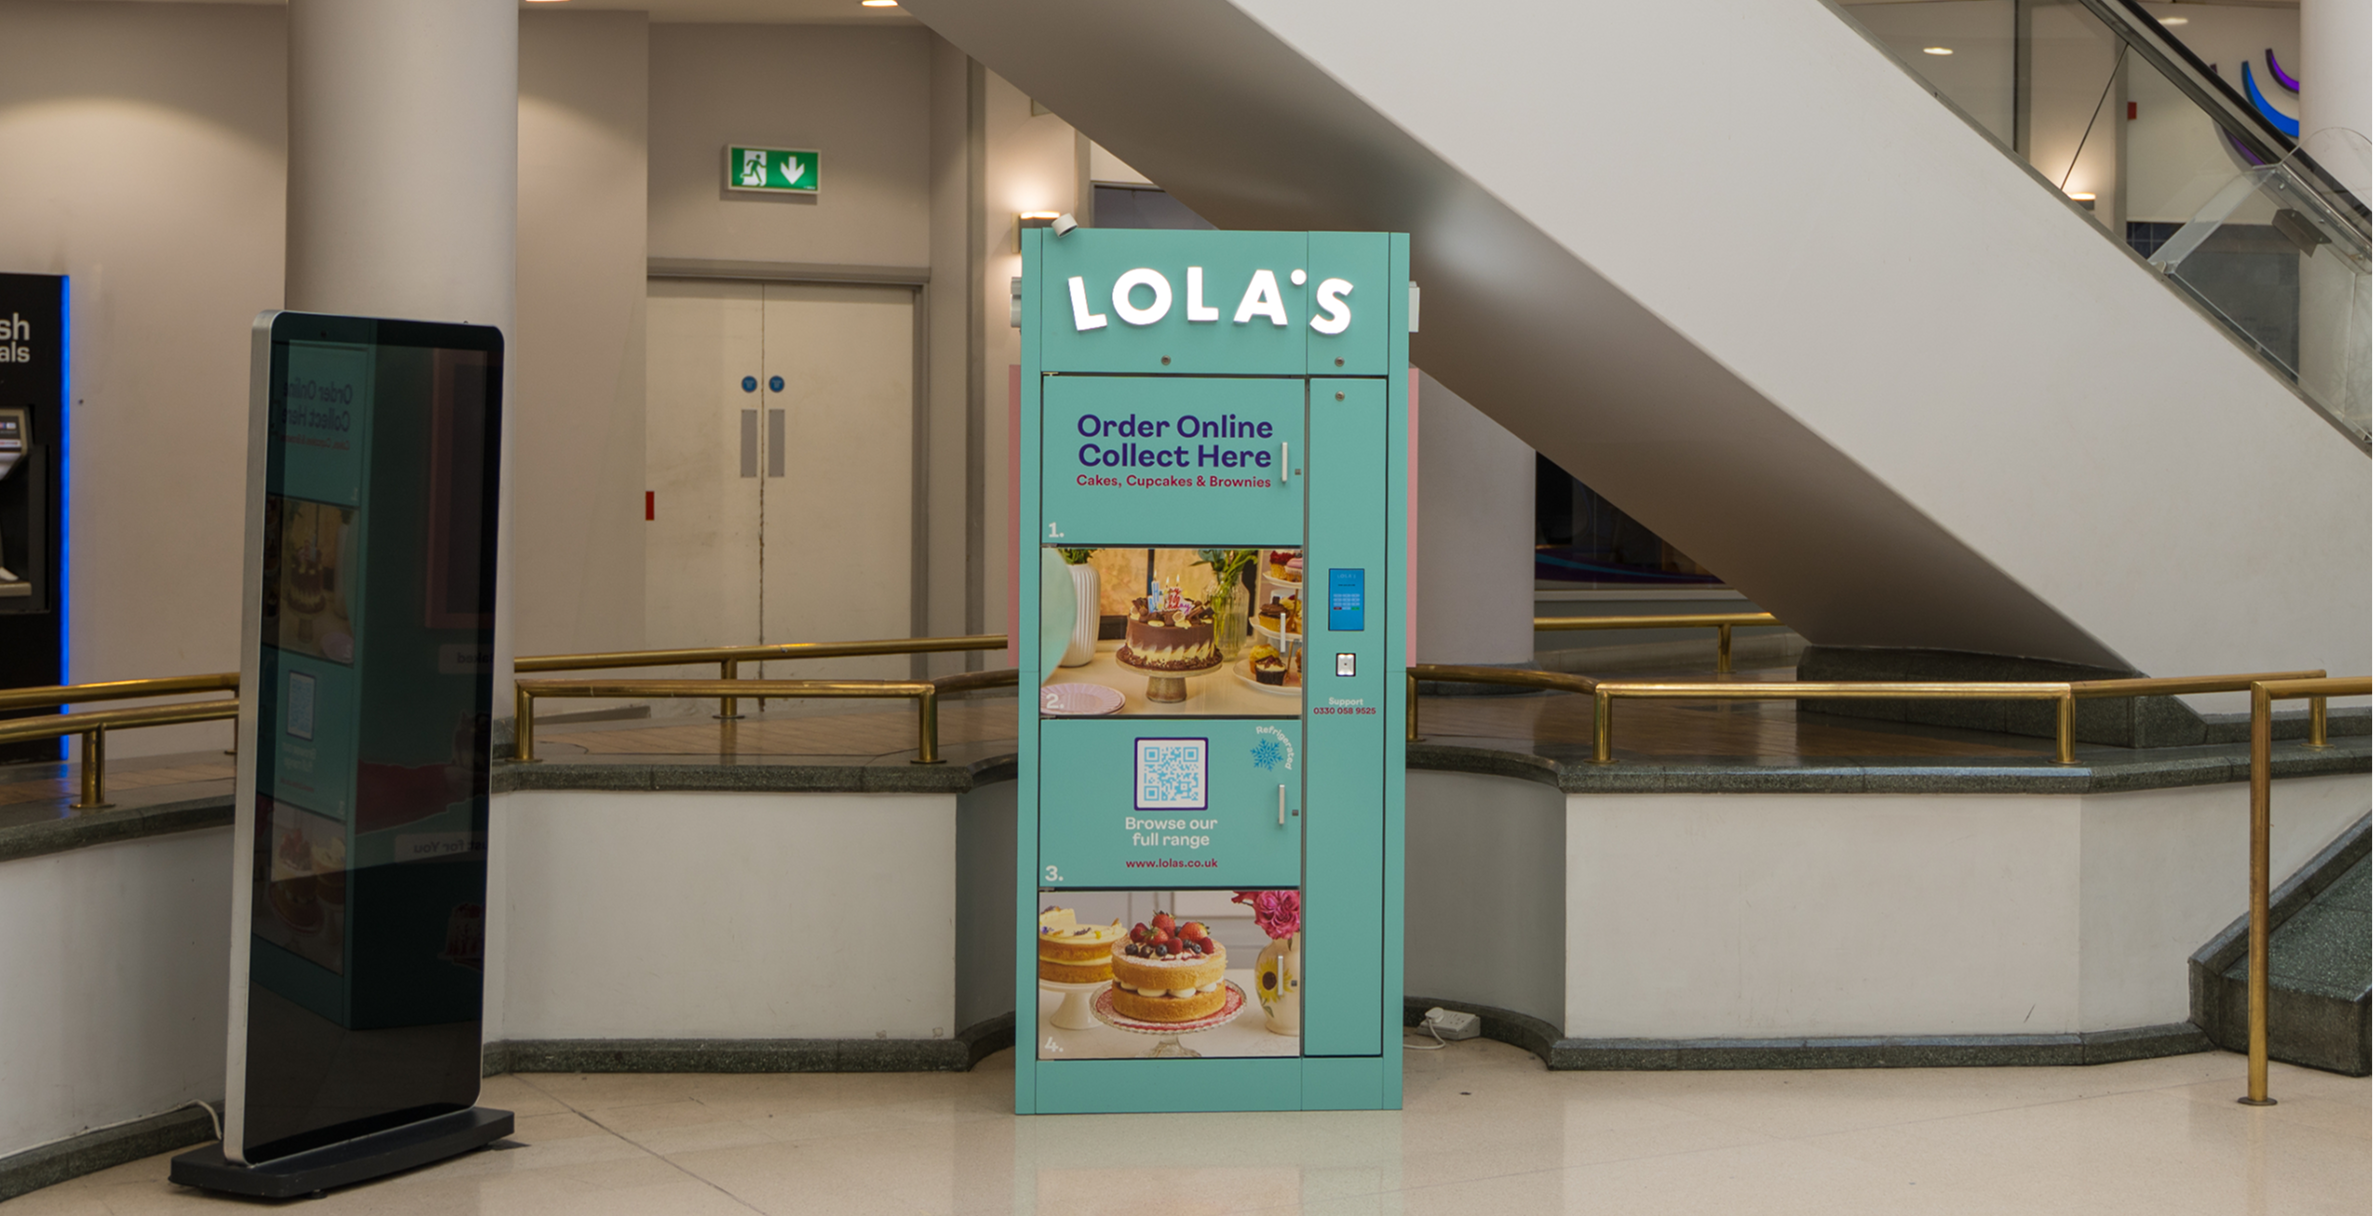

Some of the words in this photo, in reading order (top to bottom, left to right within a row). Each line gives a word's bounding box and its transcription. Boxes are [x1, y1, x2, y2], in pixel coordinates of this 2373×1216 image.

[1068, 266, 1354, 335] LOLA'S
[1077, 414, 1170, 438] Order
[1177, 414, 1273, 438] Online
[1078, 443, 1189, 468] Collect
[1198, 445, 1271, 468] Here
[1076, 474, 1122, 488] Cakes,
[1126, 475, 1192, 489] Cupcakes
[1196, 475, 1206, 487] &
[1209, 475, 1271, 488] Brownies
[1048, 522, 1065, 538] 1.
[1045, 694, 1065, 709] 2.
[1328, 697, 1364, 707] Support
[1313, 707, 1336, 715] 0330
[1337, 707, 1354, 715] 058
[1355, 707, 1377, 715] 9525
[1256, 725, 1295, 771] Refrigerated
[1125, 816, 1186, 830] Browse
[1189, 819, 1218, 830] our
[1132, 832, 1159, 846] full
[1162, 835, 1210, 849] range
[1125, 858, 1219, 868] www.lolas.co.uk
[1045, 865, 1064, 882] 3.
[1044, 1037, 1064, 1053] 4.
